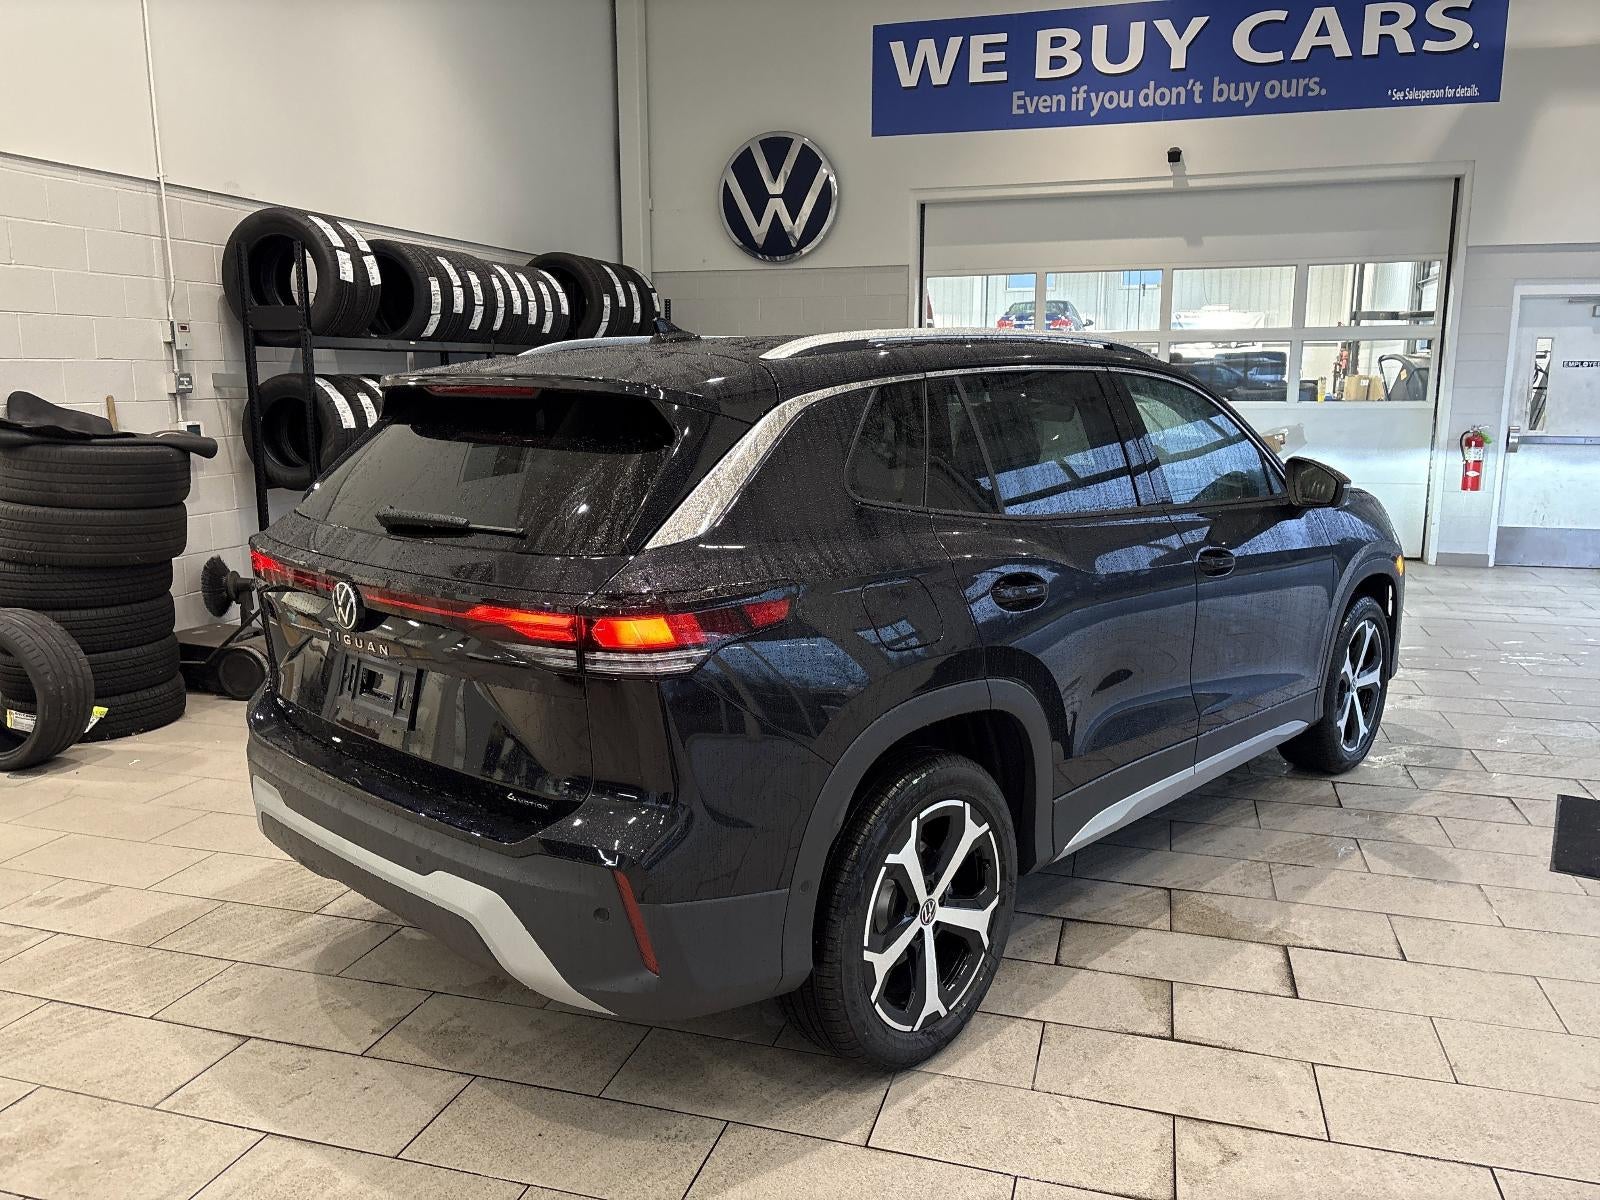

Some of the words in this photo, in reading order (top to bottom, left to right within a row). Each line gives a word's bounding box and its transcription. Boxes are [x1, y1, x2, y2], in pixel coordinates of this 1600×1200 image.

[888, 33, 1009, 88] WE
[1034, 15, 1211, 79] BUY
[1011, 90, 1067, 115] Even
[1070, 84, 1088, 112] if
[1089, 89, 1134, 118] you
[1138, 79, 1204, 108] don't
[1212, 75, 1261, 108] buy
[1264, 76, 1327, 100] ours.
[1404, 86, 1445, 102] Salesperson
[1444, 85, 1456, 98] for
[1455, 83, 1480, 98] details.
[325, 627, 390, 656] TIGUAN
